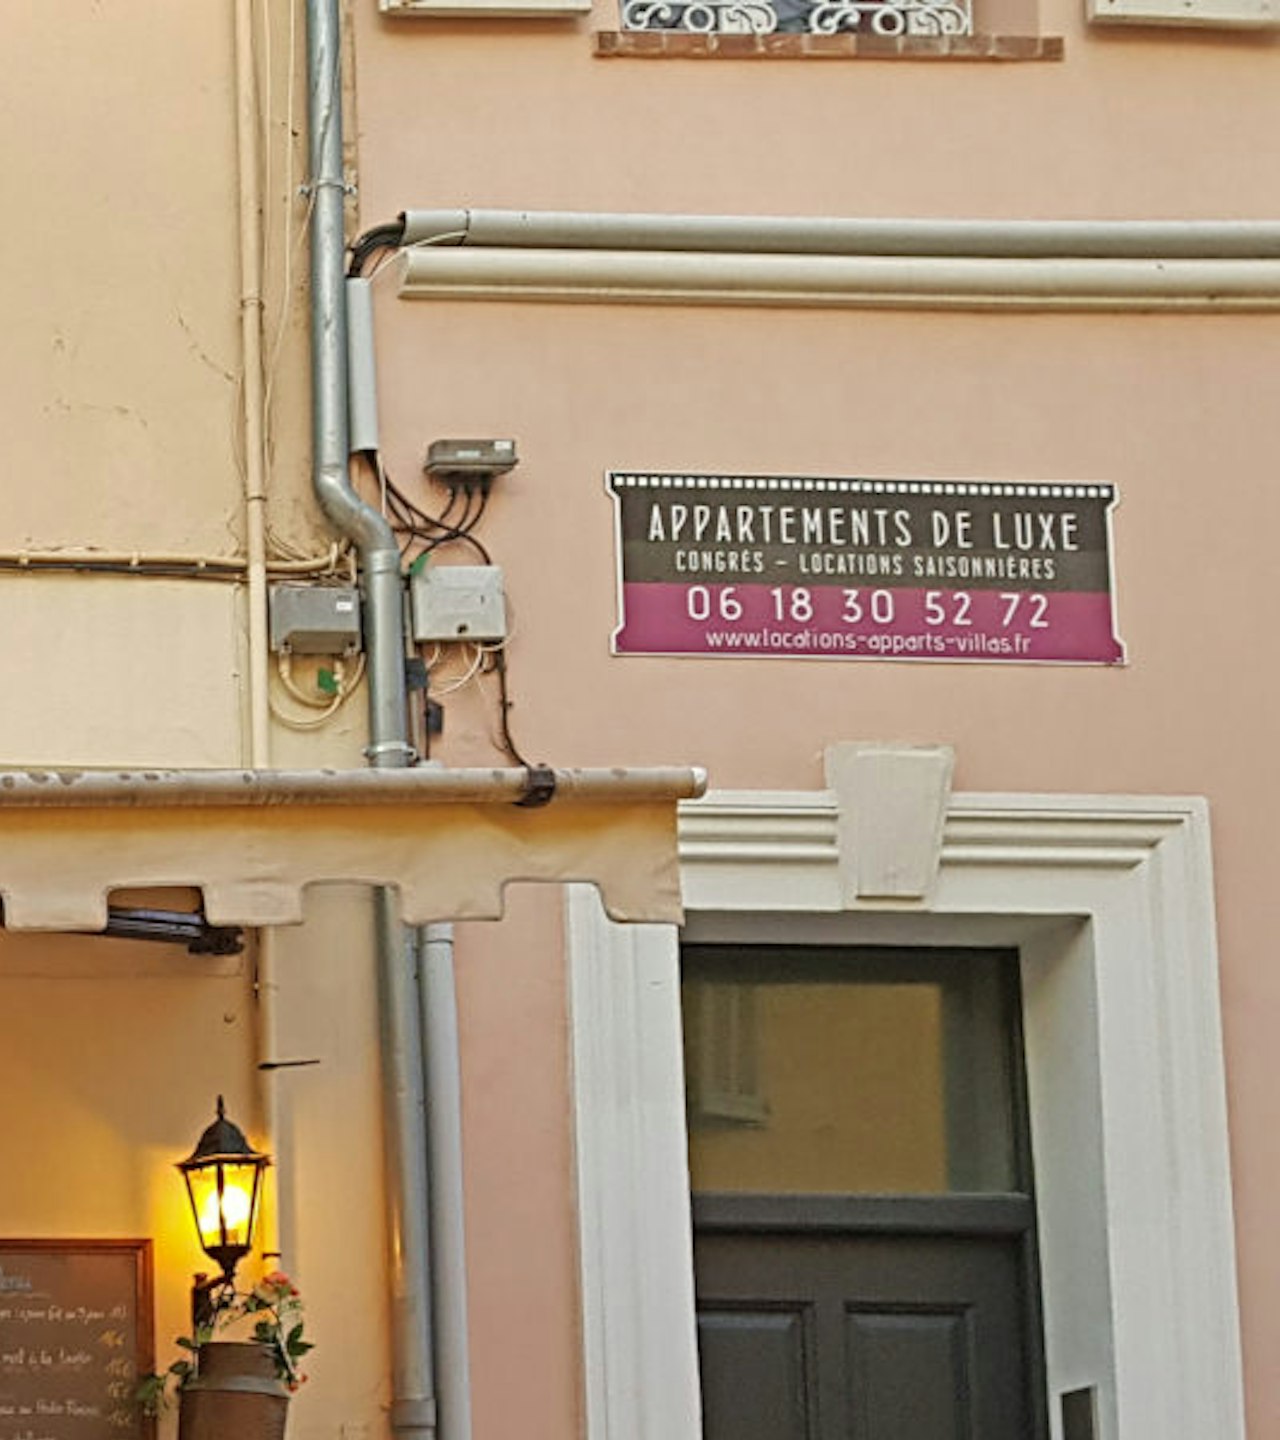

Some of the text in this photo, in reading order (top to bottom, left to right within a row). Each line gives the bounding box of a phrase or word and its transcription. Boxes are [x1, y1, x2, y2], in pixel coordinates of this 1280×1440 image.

[649, 504, 1079, 551] APPARTEMENTS DE LUXE
[799, 552, 903, 576] LOCATIONS
[688, 585, 1049, 628] 06 18 30 52 72
[705, 628, 1032, 654] www.locations-apparts-villas.fr
